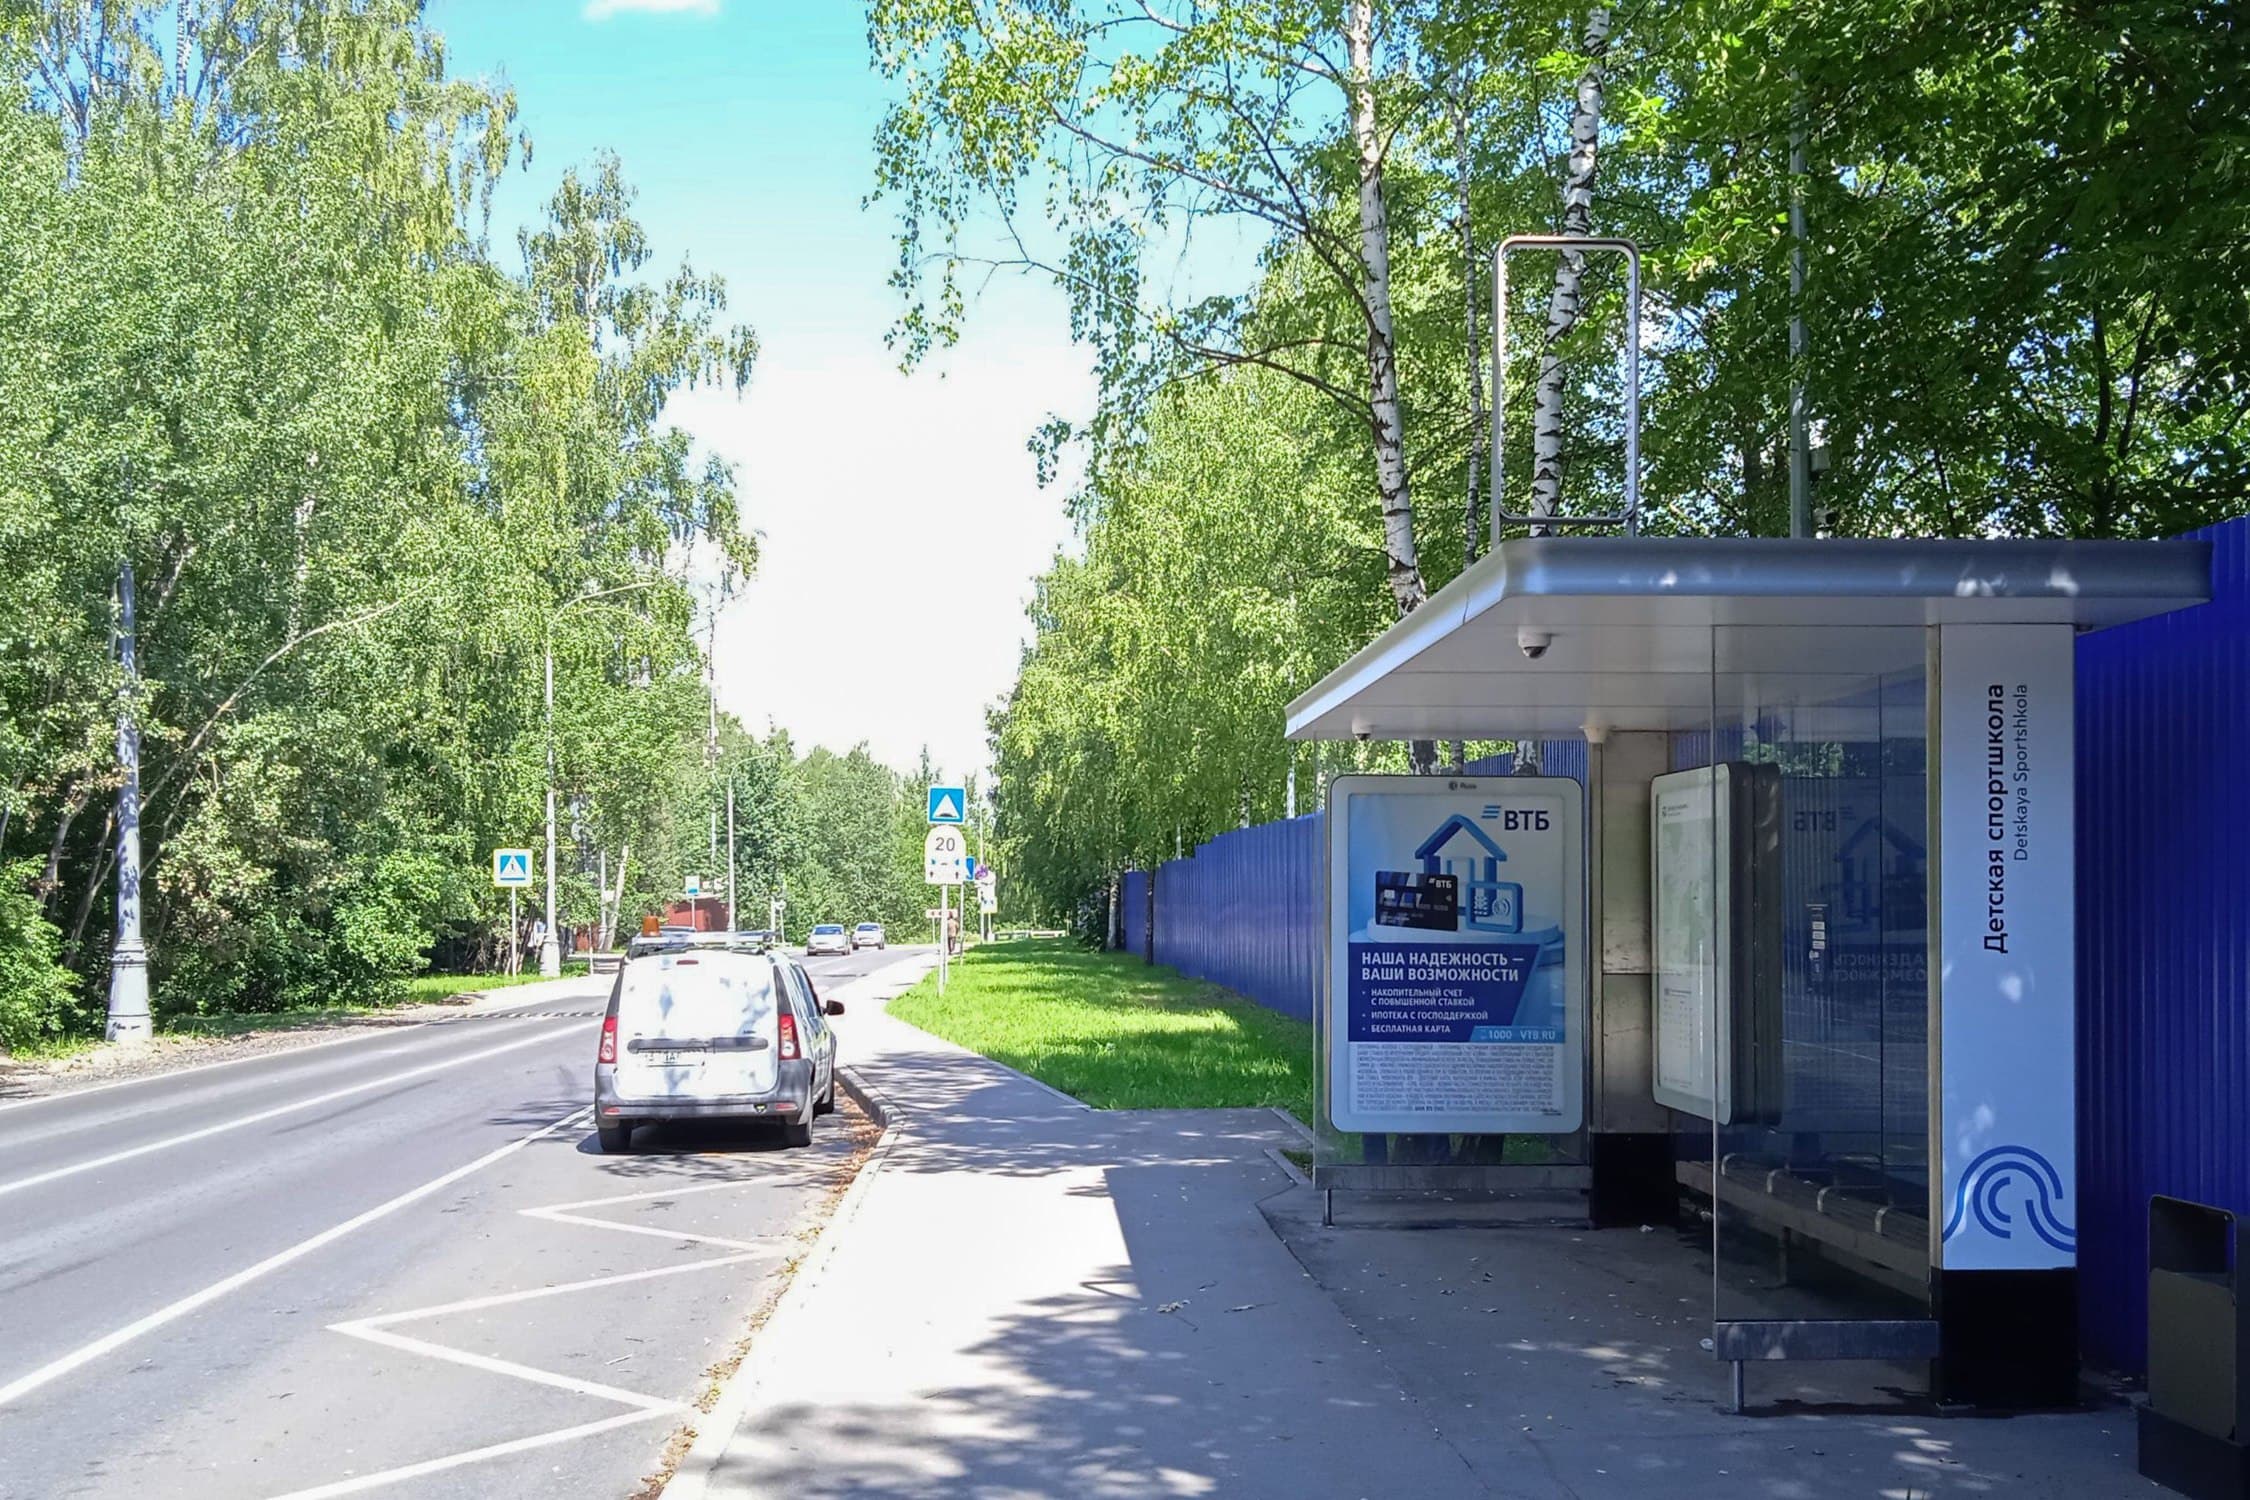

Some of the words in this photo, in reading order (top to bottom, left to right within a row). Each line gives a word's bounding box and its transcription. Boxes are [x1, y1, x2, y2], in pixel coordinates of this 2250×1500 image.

[2013, 684, 2031, 781] Sportshkola
[1987, 684, 2008, 840] спортшкола
[1504, 810, 1550, 831] ВТБ
[2014, 788, 2031, 861] Detskaya
[935, 837, 956, 851] 20
[1984, 850, 2008, 954] Детская
[1362, 952, 1405, 965] НАША
[1409, 952, 1508, 967] НАДЕЖНОСТЬ
[1362, 968, 1404, 981] ВАШИ
[1408, 968, 1519, 982] ВОЗМОЖНОСТИ
[1371, 988, 1442, 997] НАКОПИТЕЛЬНЫЙ
[1443, 989, 1463, 997] СЧЕТ
[1378, 997, 1437, 1006] ПОВЫШЕННОЙ
[1438, 997, 1475, 1007] СТАВКОЙ
[1371, 1012, 1409, 1020] ИПОТЕКА
[1417, 1010, 1488, 1021] ГОСПОДДЕРЖКОЙ
[1371, 1025, 1423, 1033] БЕСПЛАТНАЯ
[1424, 1025, 1451, 1033] КАРТА
[1488, 1030, 1513, 1039] 1000
[1520, 1031, 1556, 1040] VTB.RU
